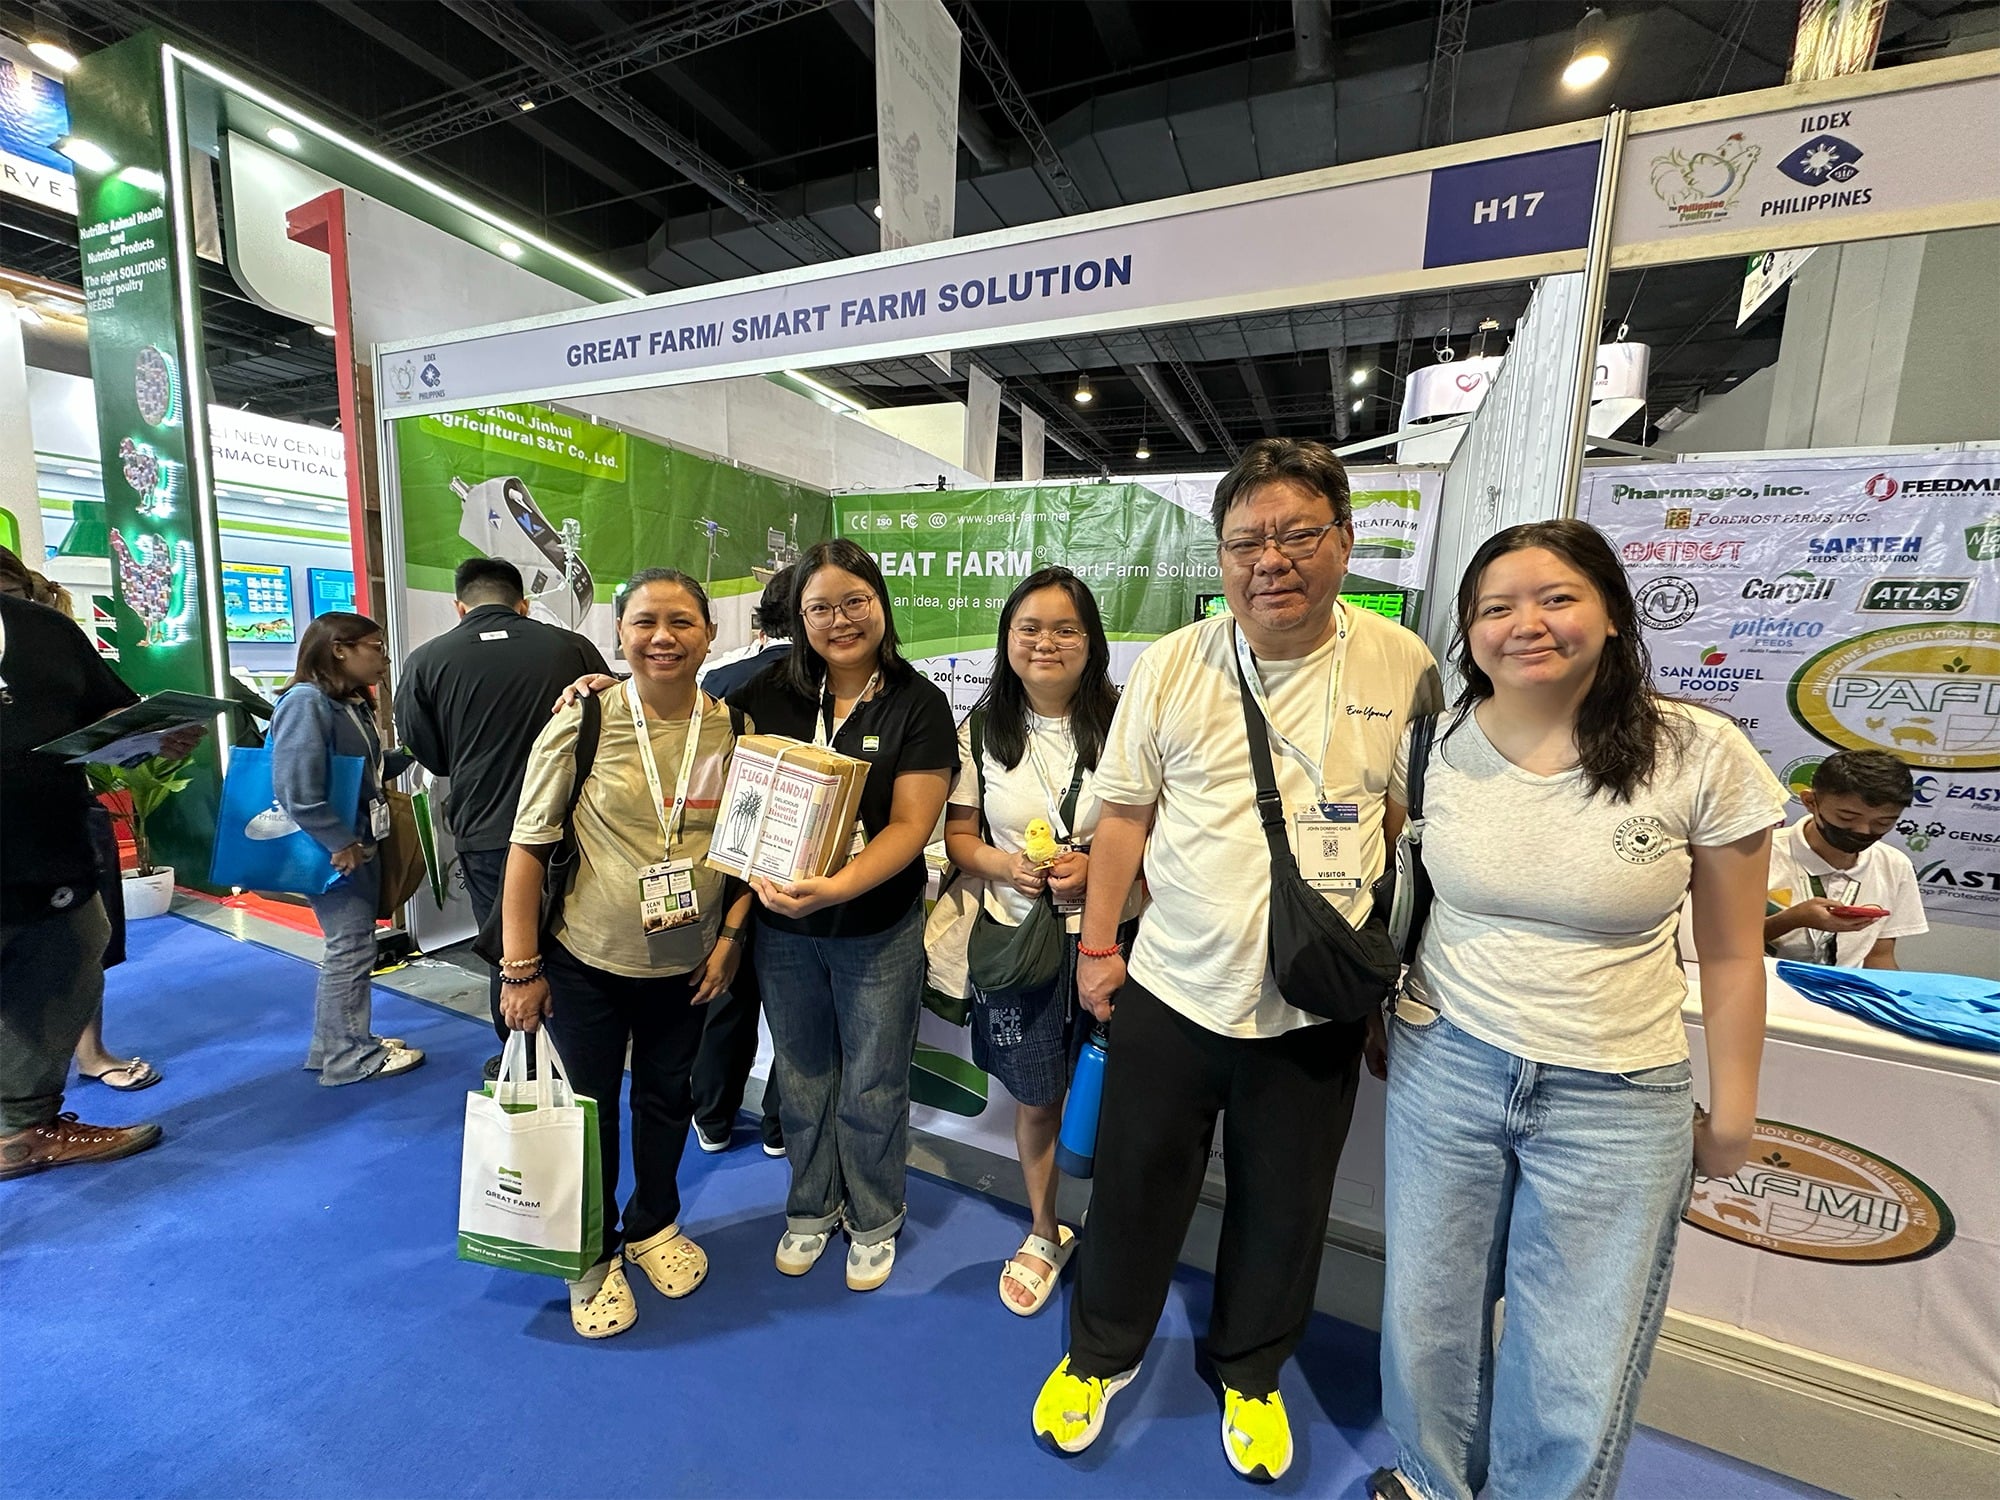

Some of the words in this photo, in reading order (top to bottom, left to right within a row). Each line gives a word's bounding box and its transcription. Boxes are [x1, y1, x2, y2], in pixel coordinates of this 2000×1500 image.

[1800, 111, 1852, 133] ILDEX
[1473, 191, 1545, 225] H17
[1677, 200, 1725, 214] Philippine
[1760, 188, 1873, 217] PHILIPPINES
[80, 223, 110, 241] NutriBiz
[110, 214, 137, 233] Animal
[137, 207, 163, 224] Health
[1679, 211, 1713, 222] Poultry
[110, 231, 126, 245] and
[88, 247, 120, 264] Nutrition
[120, 238, 155, 257] Products
[85, 273, 99, 287] The
[100, 269, 119, 286] right
[120, 258, 167, 280] SOLUTIONS
[98, 285, 115, 301] your
[116, 279, 144, 297] poultry
[88, 300, 115, 312] NEEDS!
[567, 335, 641, 368] GREAT
[649, 321, 724, 354] FARM/
[733, 304, 831, 344] SMART
[841, 287, 927, 328] FARM
[938, 254, 1133, 311] SOLUTION
[527, 418, 573, 439] Jinhui
[235, 428, 278, 449] NEW
[429, 413, 534, 446] Agricultural
[536, 436, 565, 454] S&T
[568, 445, 592, 464] Co.,
[594, 452, 619, 469] Ltd.
[1611, 484, 1758, 505] Pharmagro,
[1763, 484, 1810, 498] inc.
[876, 517, 892, 527] ISO
[957, 511, 1071, 526] www.great-farm.net
[1352, 518, 1418, 531] REATFARM
[1693, 512, 1782, 527] FOREMOST
[1837, 513, 1871, 524] INC.
[1808, 536, 1924, 554] SANTEH
[946, 551, 1033, 577] FARM
[1806, 555, 1838, 564] FEEDS
[1841, 554, 1919, 564] CORPORATION
[1105, 562, 1150, 577] Farm
[1741, 576, 1836, 605] Cargill
[1873, 586, 1960, 600] ATLAS
[894, 596, 909, 607] an
[913, 594, 943, 609] idea,
[948, 595, 968, 610] get
[972, 597, 980, 608] a
[1754, 638, 1793, 648] FEEDS
[1812, 647, 1866, 696] PHILIPPINE
[1866, 629, 1971, 652] ASSOCIATION
[1974, 630, 1997, 640] OF
[1660, 666, 1693, 678] SAN
[1698, 667, 1764, 680] MIGUEL
[1679, 679, 1740, 692] FOODS
[1920, 755, 1956, 765] 1951
[768, 807, 797, 824] Biscuits
[773, 802, 798, 816] Assorted
[1615, 818, 1645, 852] AMERICAN
[646, 901, 661, 909] SCAN
[1792, 1134, 1815, 1146] OF
[1818, 1138, 1861, 1163] FEED
[485, 1189, 511, 1204] GREAT
[513, 1200, 541, 1209] FARM
[1744, 1231, 1779, 1248] 1951
